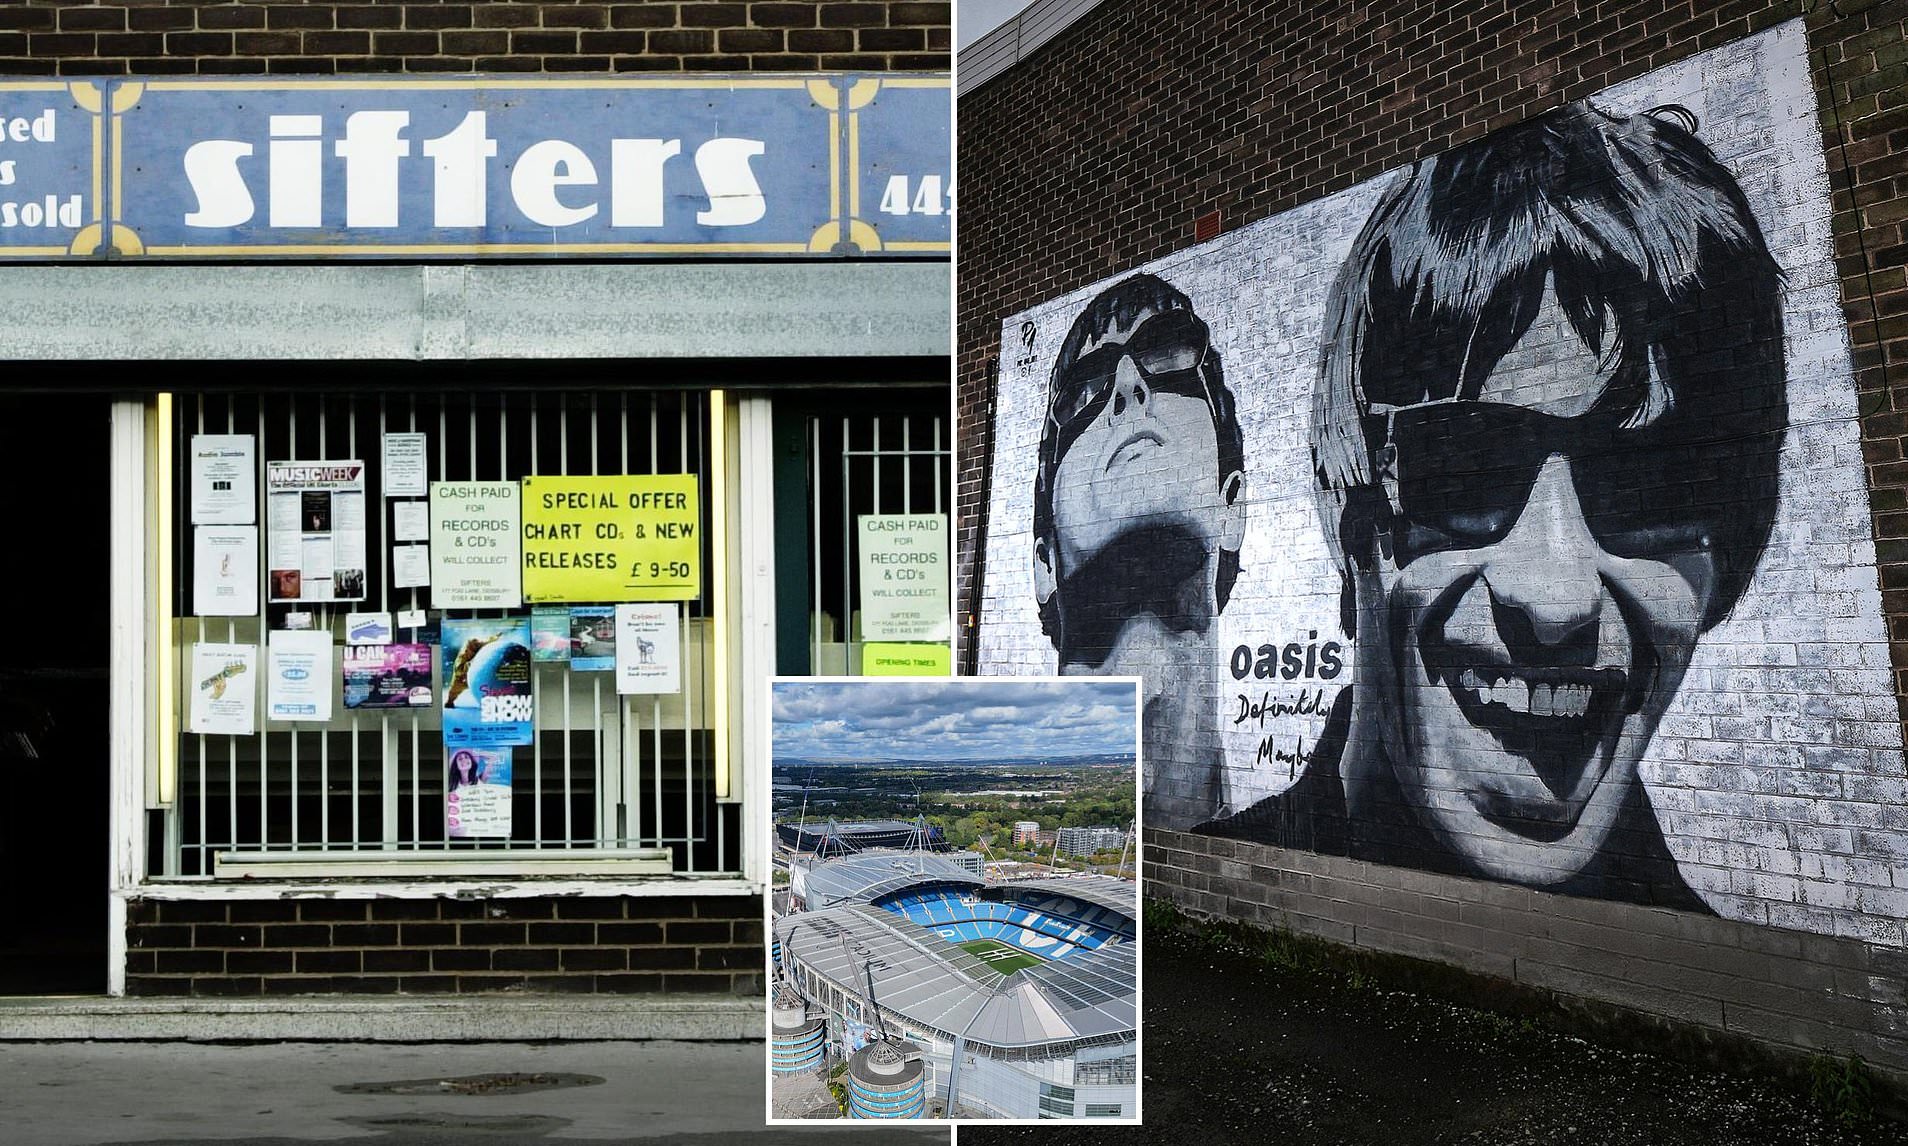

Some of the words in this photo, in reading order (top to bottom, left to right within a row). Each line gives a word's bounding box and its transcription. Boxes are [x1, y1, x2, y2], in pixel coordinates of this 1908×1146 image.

[183, 110, 767, 228] sifters
[880, 175, 951, 215] 44
[1, 194, 82, 227] sold
[440, 487, 476, 498] CASH
[481, 487, 511, 498] PAID
[543, 492, 618, 509] SPECIAL
[629, 493, 687, 509] OFFER
[465, 504, 485, 512] FOR
[442, 520, 509, 531] RECORDS
[525, 523, 582, 540] CHART
[636, 524, 646, 539] &
[656, 523, 694, 539] NEW
[867, 520, 904, 531] CASH
[909, 520, 939, 531] PAID
[455, 536, 463, 547] &
[468, 536, 496, 547] CD's
[894, 537, 913, 545] FOR
[442, 555, 465, 564] WILL
[466, 555, 508, 564] COLLECT
[526, 552, 617, 569] RELEASES
[871, 552, 938, 564] RECORDS
[884, 568, 892, 580] &
[896, 568, 926, 580] CD's
[872, 589, 894, 597] WILL
[896, 588, 937, 597] COLLECT
[1230, 630, 1342, 680] oasis
[1234, 689, 1331, 728] Definitely
